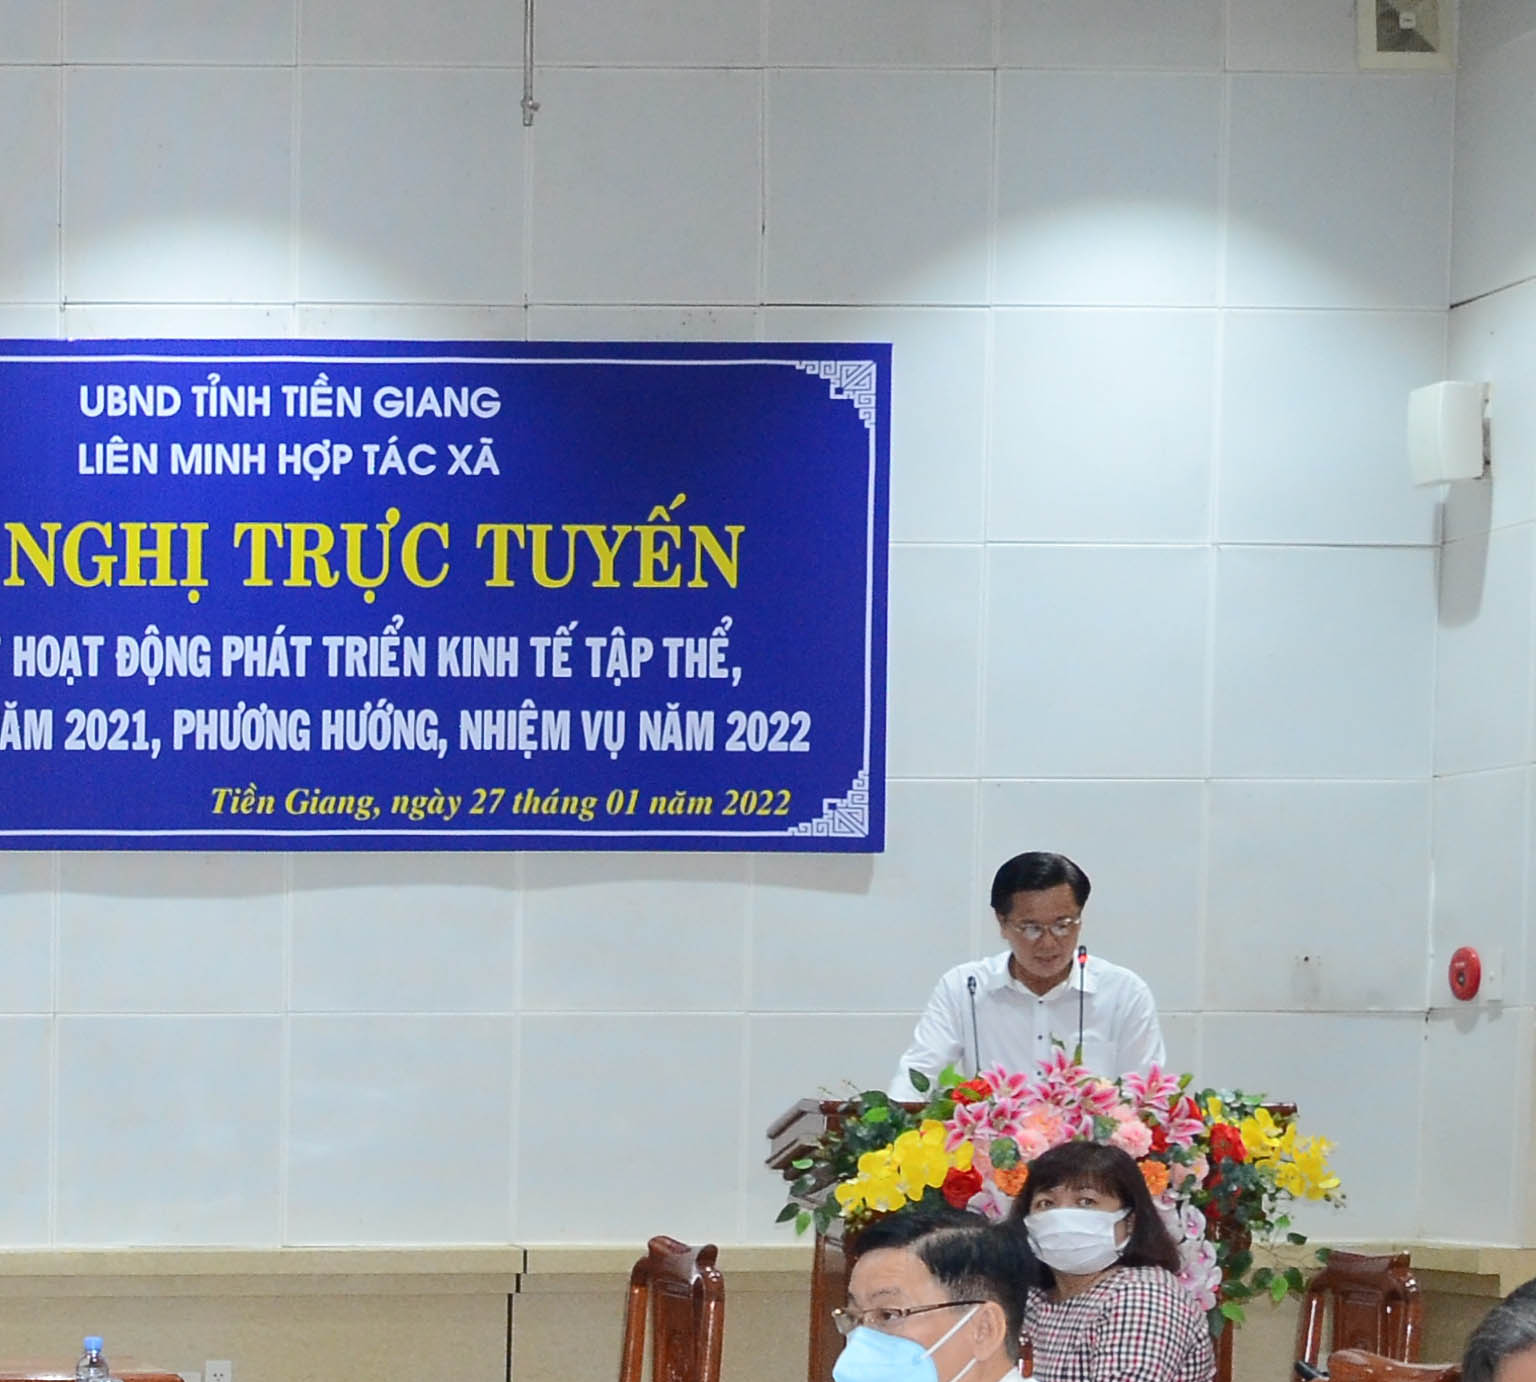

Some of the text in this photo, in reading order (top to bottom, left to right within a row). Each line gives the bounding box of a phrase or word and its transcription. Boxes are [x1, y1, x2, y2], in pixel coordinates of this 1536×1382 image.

[79, 373, 501, 419] UBND TỈNH TIỀN GIANG
[78, 435, 500, 482] LIÊN MINH HỢP TÁC XÃ
[4, 521, 209, 603] NGHỊ
[234, 507, 450, 604] TRỰC
[476, 495, 745, 589] TUYẾN
[13, 634, 105, 686] HOẠT
[115, 624, 211, 686] ĐỘNG
[222, 624, 313, 678] PHÁT
[322, 614, 426, 677] TRIỂN
[437, 636, 519, 678] KINH
[529, 620, 578, 678] TẾ
[585, 626, 654, 687] TẬP
[662, 615, 742, 687] THỂ,
[64, 708, 161, 759] 2021,
[173, 700, 311, 751] PHƯƠNG
[321, 698, 448, 759] HƯỚNG,
[459, 699, 571, 760] NHIỆM
[581, 710, 626, 760] VỤ
[639, 702, 715, 752] NĂM
[725, 710, 811, 752] 2022
[211, 785, 792, 821] Tiền Giang, ngày 27 tháng 01 năm 2022
